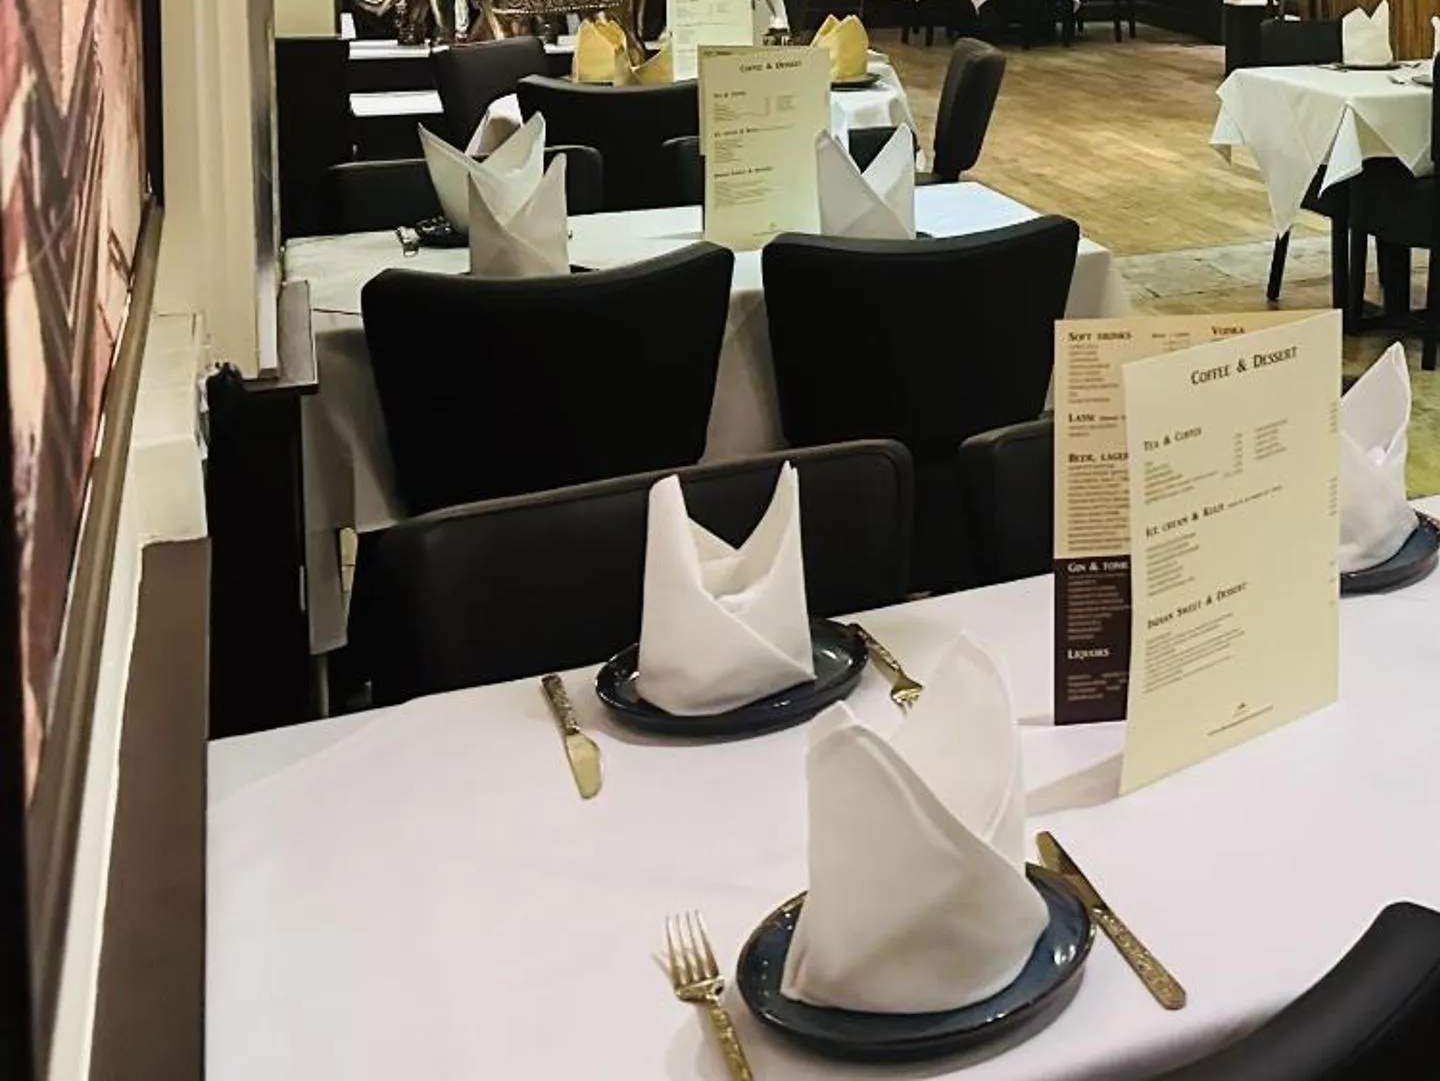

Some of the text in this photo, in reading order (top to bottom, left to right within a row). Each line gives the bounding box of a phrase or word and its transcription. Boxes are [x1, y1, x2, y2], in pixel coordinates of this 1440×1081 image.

[1068, 332, 1092, 341] SOFT
[1190, 345, 1297, 385] COFFEE & DESSERT
